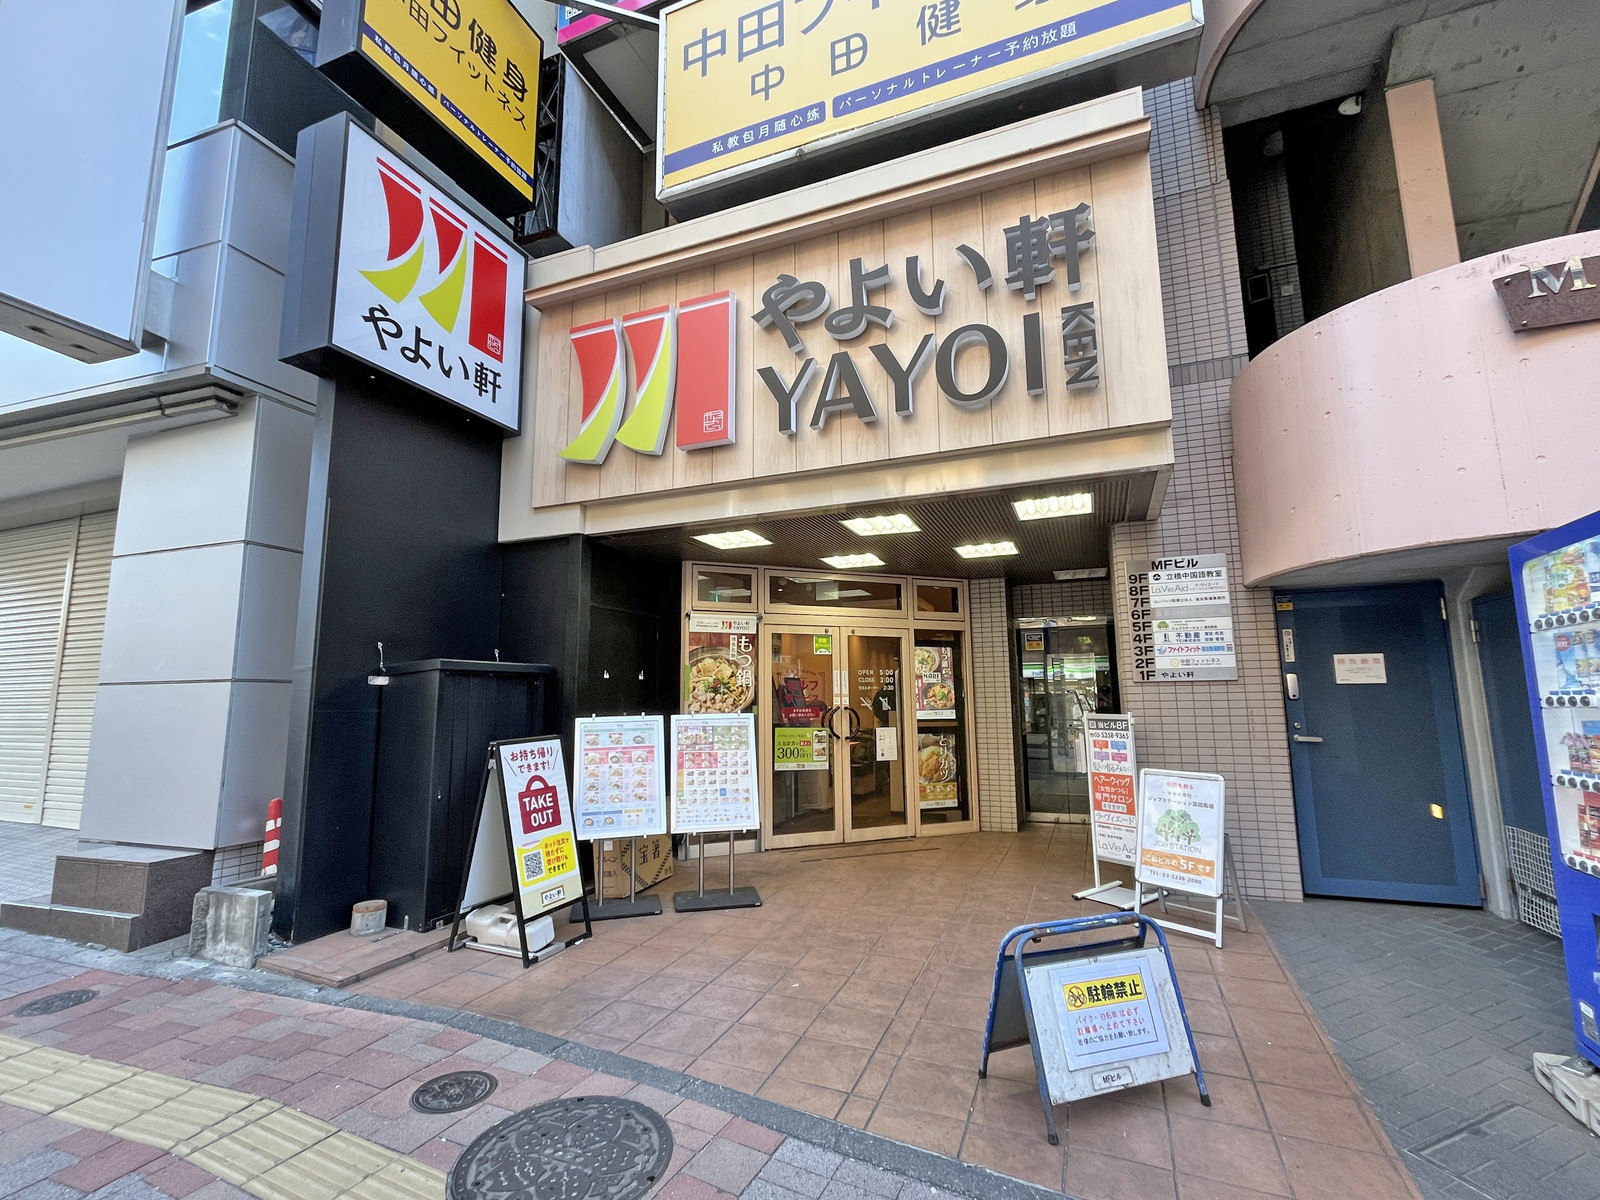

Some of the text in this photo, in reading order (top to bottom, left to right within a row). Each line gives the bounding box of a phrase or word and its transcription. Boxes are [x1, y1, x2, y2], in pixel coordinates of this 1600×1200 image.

[683, 0, 880, 78] 中田フ
[393, 0, 526, 131] 田フィットネス
[839, 20, 1078, 110] パーソナルトレーナー予約放題
[711, 107, 821, 155] 私教包月随心练
[751, 202, 1096, 355] やよい軒
[1061, 301, 1099, 391] KEN
[361, 304, 502, 404] やよい軒
[756, 312, 1045, 436] YAYOI
[1151, 558, 1199, 571] MFビル
[1128, 573, 1148, 584] 9F
[1129, 585, 1149, 596] 8F
[1130, 597, 1150, 608] 7F
[1131, 609, 1151, 620] 6F
[1132, 621, 1152, 632] 5F
[1133, 633, 1153, 644] 4F
[1134, 645, 1154, 657] 3F
[736, 635, 753, 687] もつ鍋
[1135, 658, 1155, 669] 2F
[1139, 670, 1156, 681] 1F
[510, 746, 553, 762] お持ち帰り
[777, 747, 800, 760] 300
[522, 792, 554, 812] TAKE
[530, 808, 554, 827] OUT
[1169, 842, 1202, 854] STATION
[1180, 859, 1195, 871] 5F
[1197, 864, 1211, 873] です
[1086, 978, 1143, 1003] 駐輪禁止
